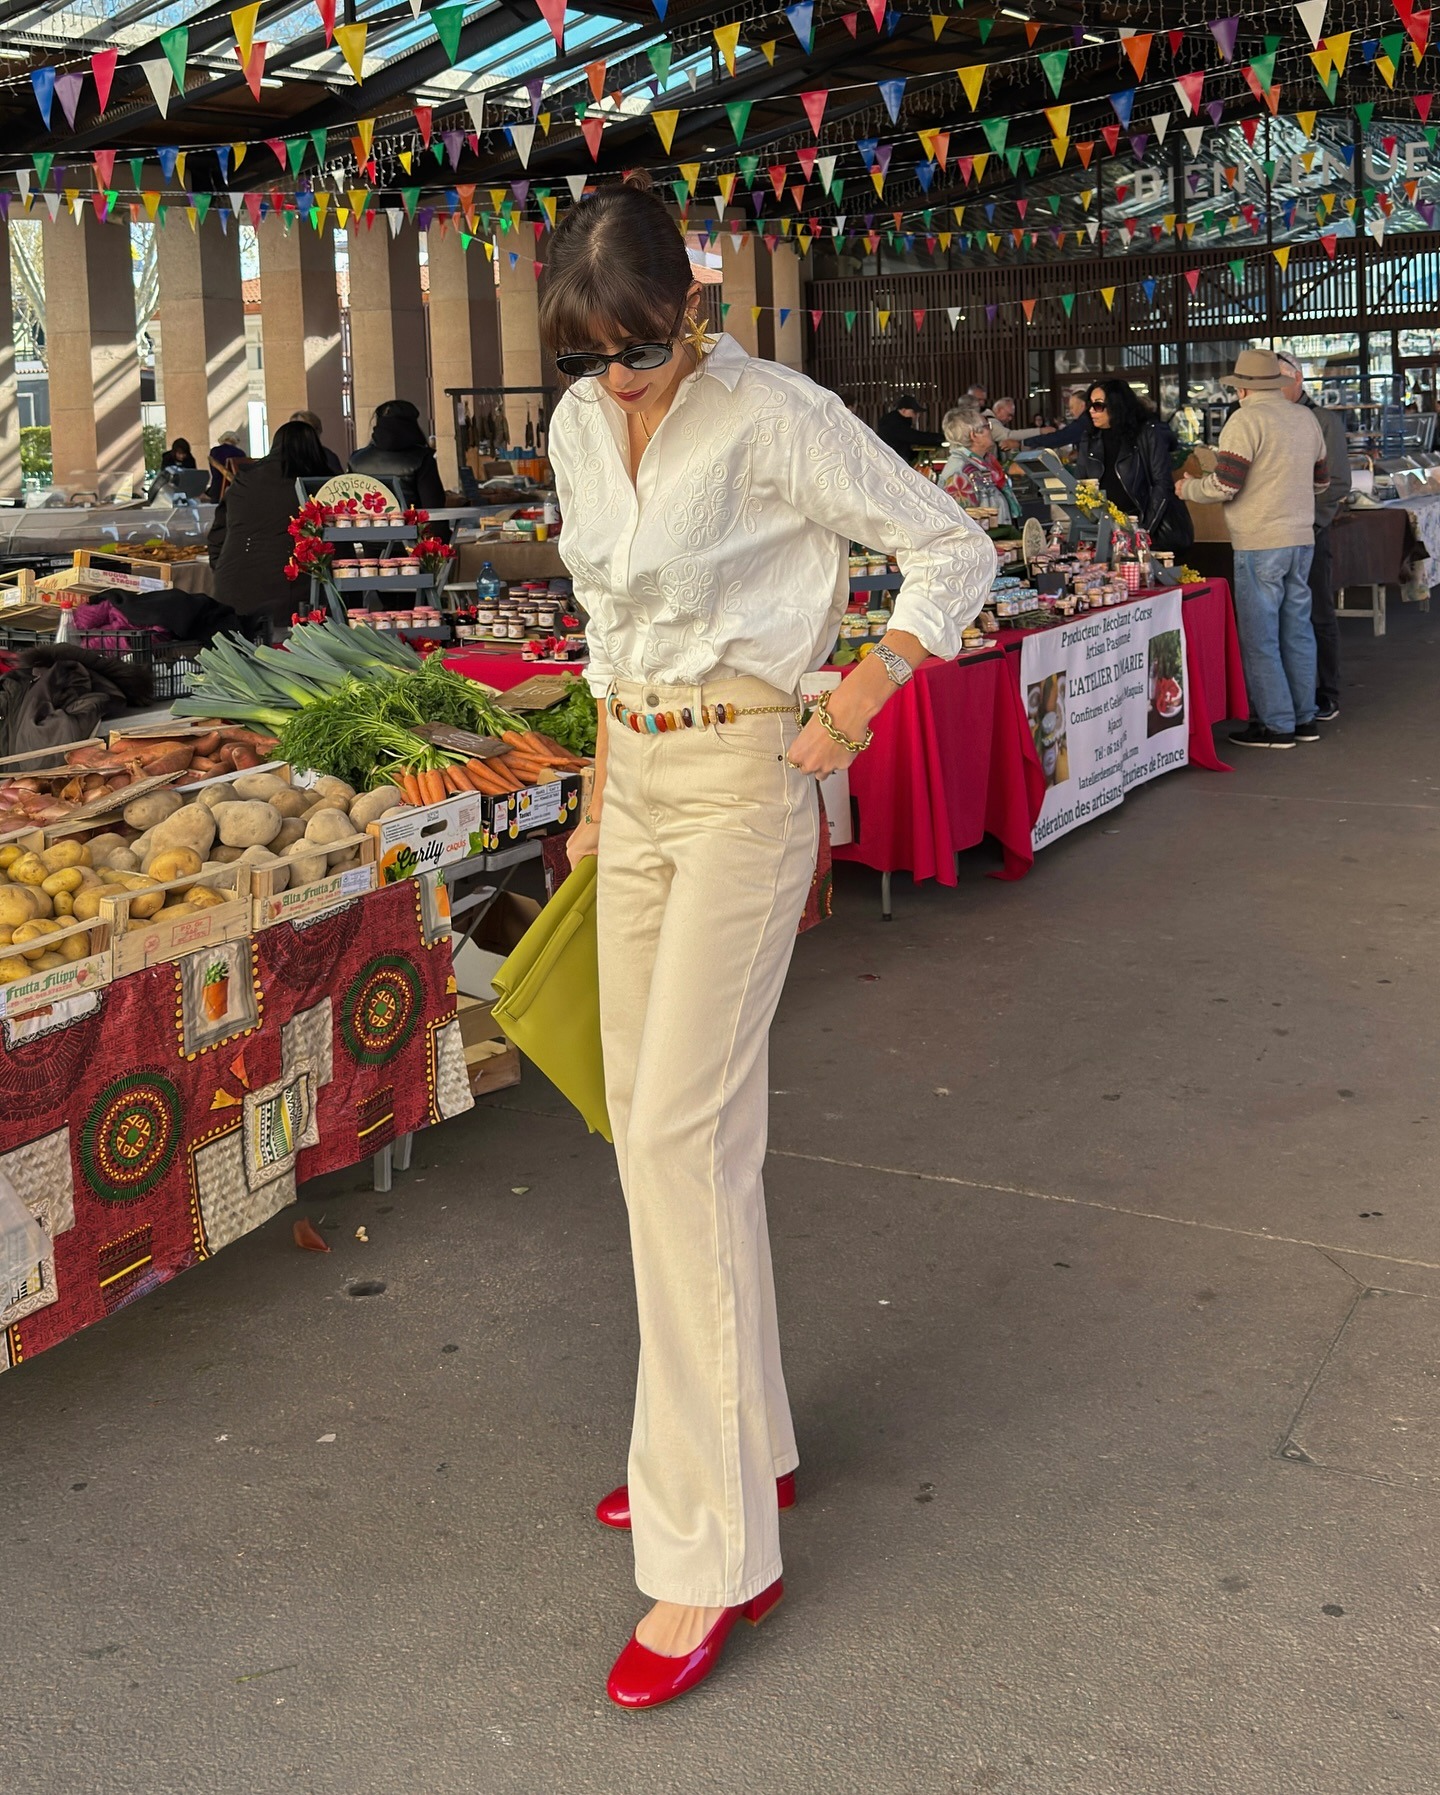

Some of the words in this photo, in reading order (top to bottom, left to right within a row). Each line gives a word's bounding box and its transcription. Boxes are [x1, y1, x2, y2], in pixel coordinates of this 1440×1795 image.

[1134, 141, 1430, 200] BIENVENUE
[325, 477, 378, 503] Hibiscus
[56, 592, 78, 603] ALTA
[1069, 664, 1113, 698] L'ATELIER
[1070, 704, 1103, 725] Confitures
[1075, 800, 1091, 819] des
[1092, 783, 1122, 811] artisans
[1157, 748, 1185, 768] France
[446, 840, 466, 852] CAQUIS
[282, 893, 301, 907] Alta
[302, 884, 329, 902] Frutta
[6, 981, 40, 1003] Frutta
[40, 966, 79, 992] Filippi
